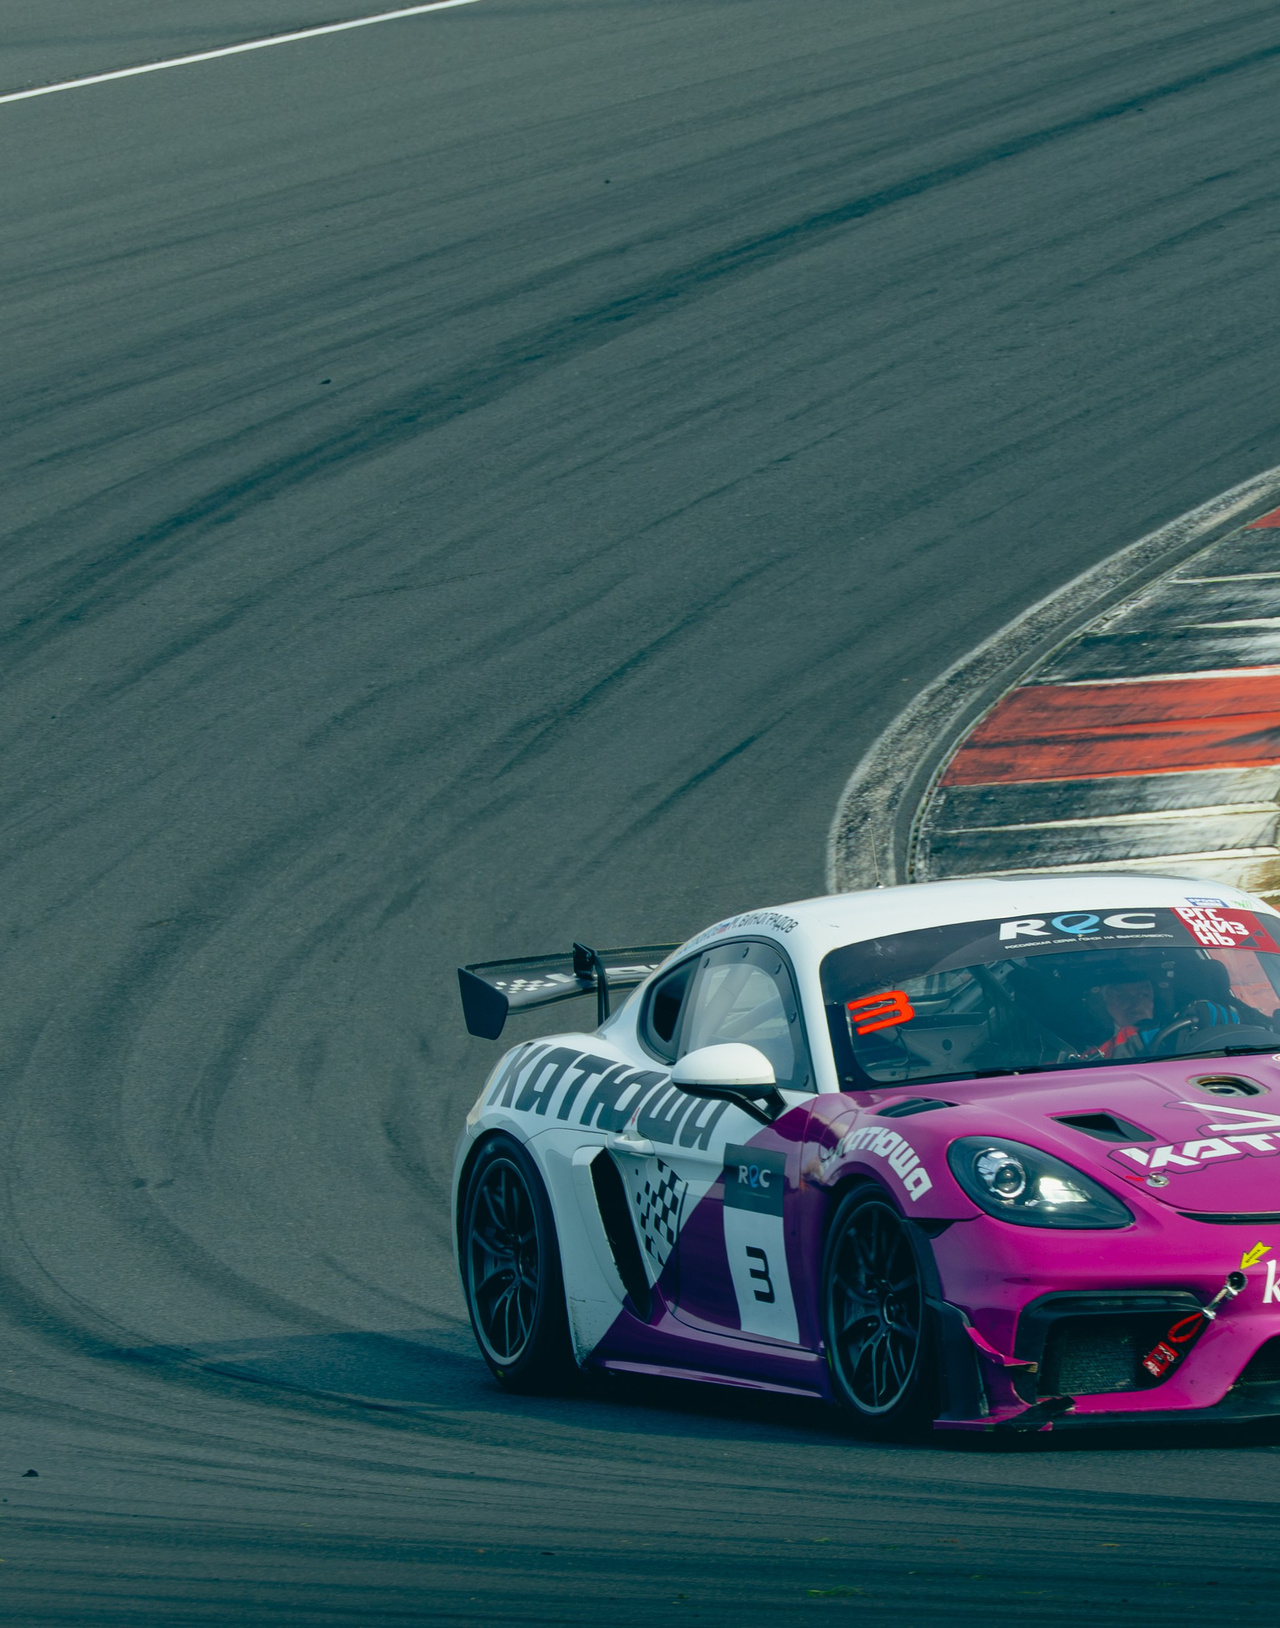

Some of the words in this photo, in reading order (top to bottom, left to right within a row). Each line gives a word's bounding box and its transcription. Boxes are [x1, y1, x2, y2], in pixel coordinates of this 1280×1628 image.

[1174, 907, 1225, 921] РГС
[846, 989, 916, 1036] 3
[745, 1245, 775, 1304] 3
